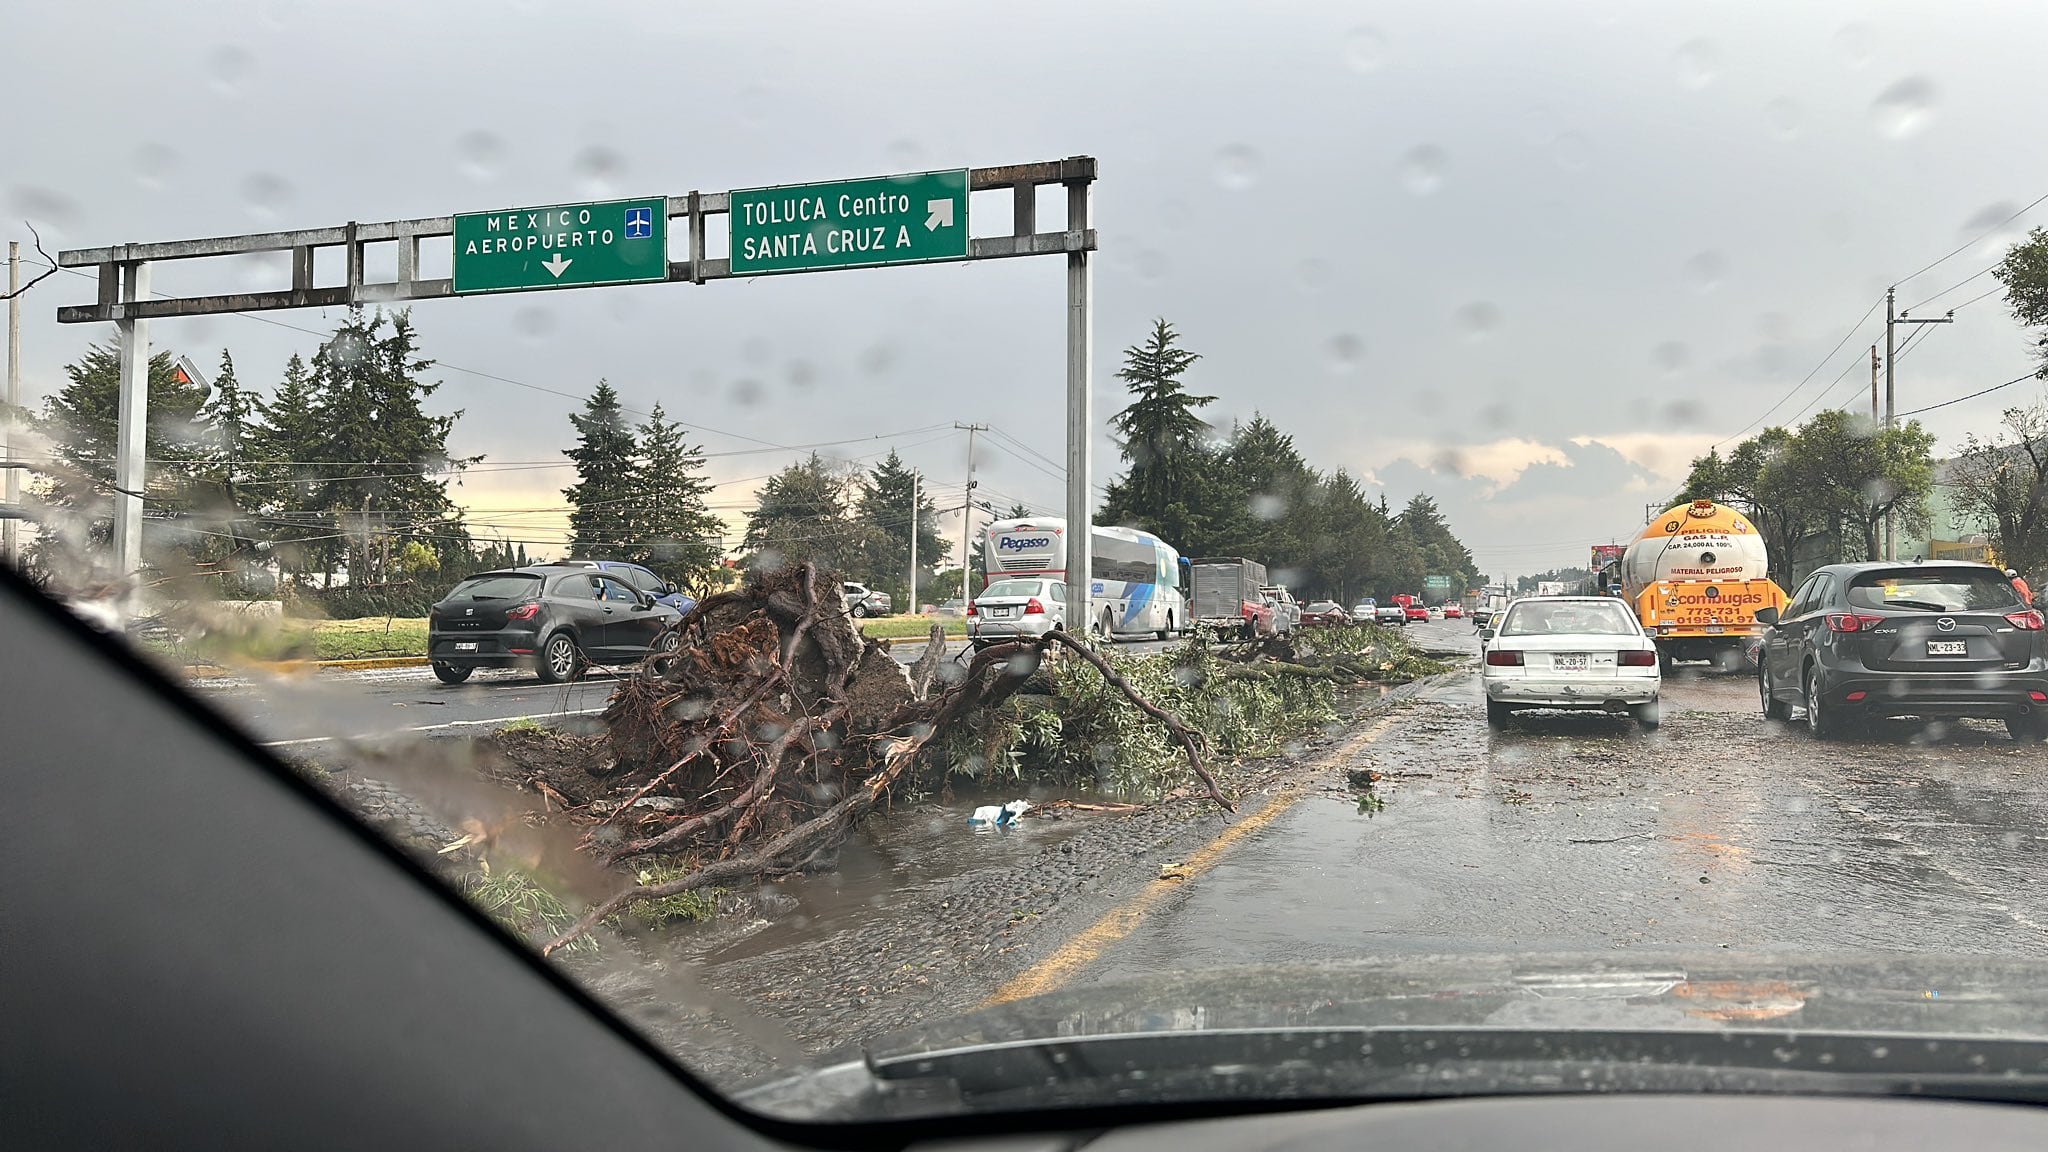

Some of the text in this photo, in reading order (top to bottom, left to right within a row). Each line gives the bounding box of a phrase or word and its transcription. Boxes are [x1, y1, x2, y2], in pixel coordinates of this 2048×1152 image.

[743, 191, 909, 226] TOLUCA Centro
[487, 209, 591, 232] MEXICO
[465, 229, 613, 255] AEROPUERTO
[743, 225, 911, 260] SANTA CRUZ A
[1000, 537, 1049, 551] Pegasso
[1706, 566, 1743, 575] PELIGROSO
[1686, 607, 1740, 615] 773-731
